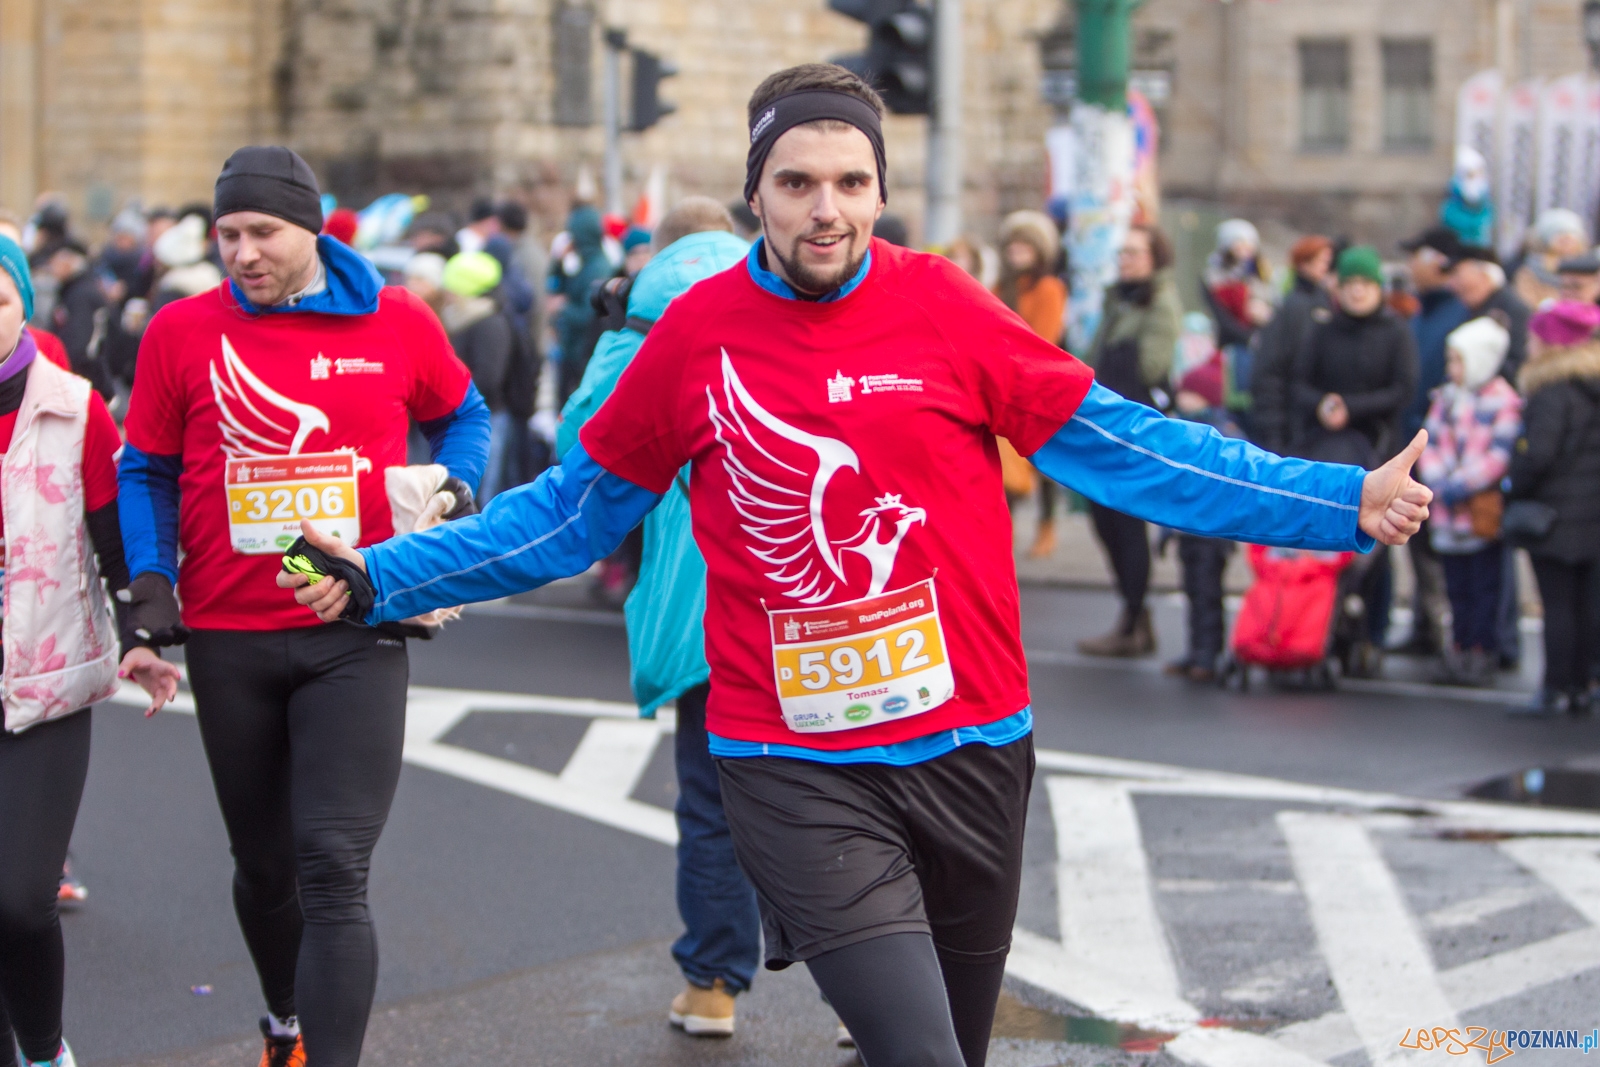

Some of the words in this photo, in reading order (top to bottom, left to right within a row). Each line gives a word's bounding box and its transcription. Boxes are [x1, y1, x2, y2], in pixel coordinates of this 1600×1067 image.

[858, 375, 872, 394] 1
[295, 464, 347, 474] RunPoland.org
[232, 501, 242, 512] D
[244, 486, 345, 520] 3206
[858, 598, 925, 625] RunPoland.org
[780, 667, 793, 681] D
[799, 629, 930, 691] 5912
[846, 687, 889, 700] Tomasz
[793, 713, 819, 722] GRUPA
[794, 719, 825, 728] LUXMED
